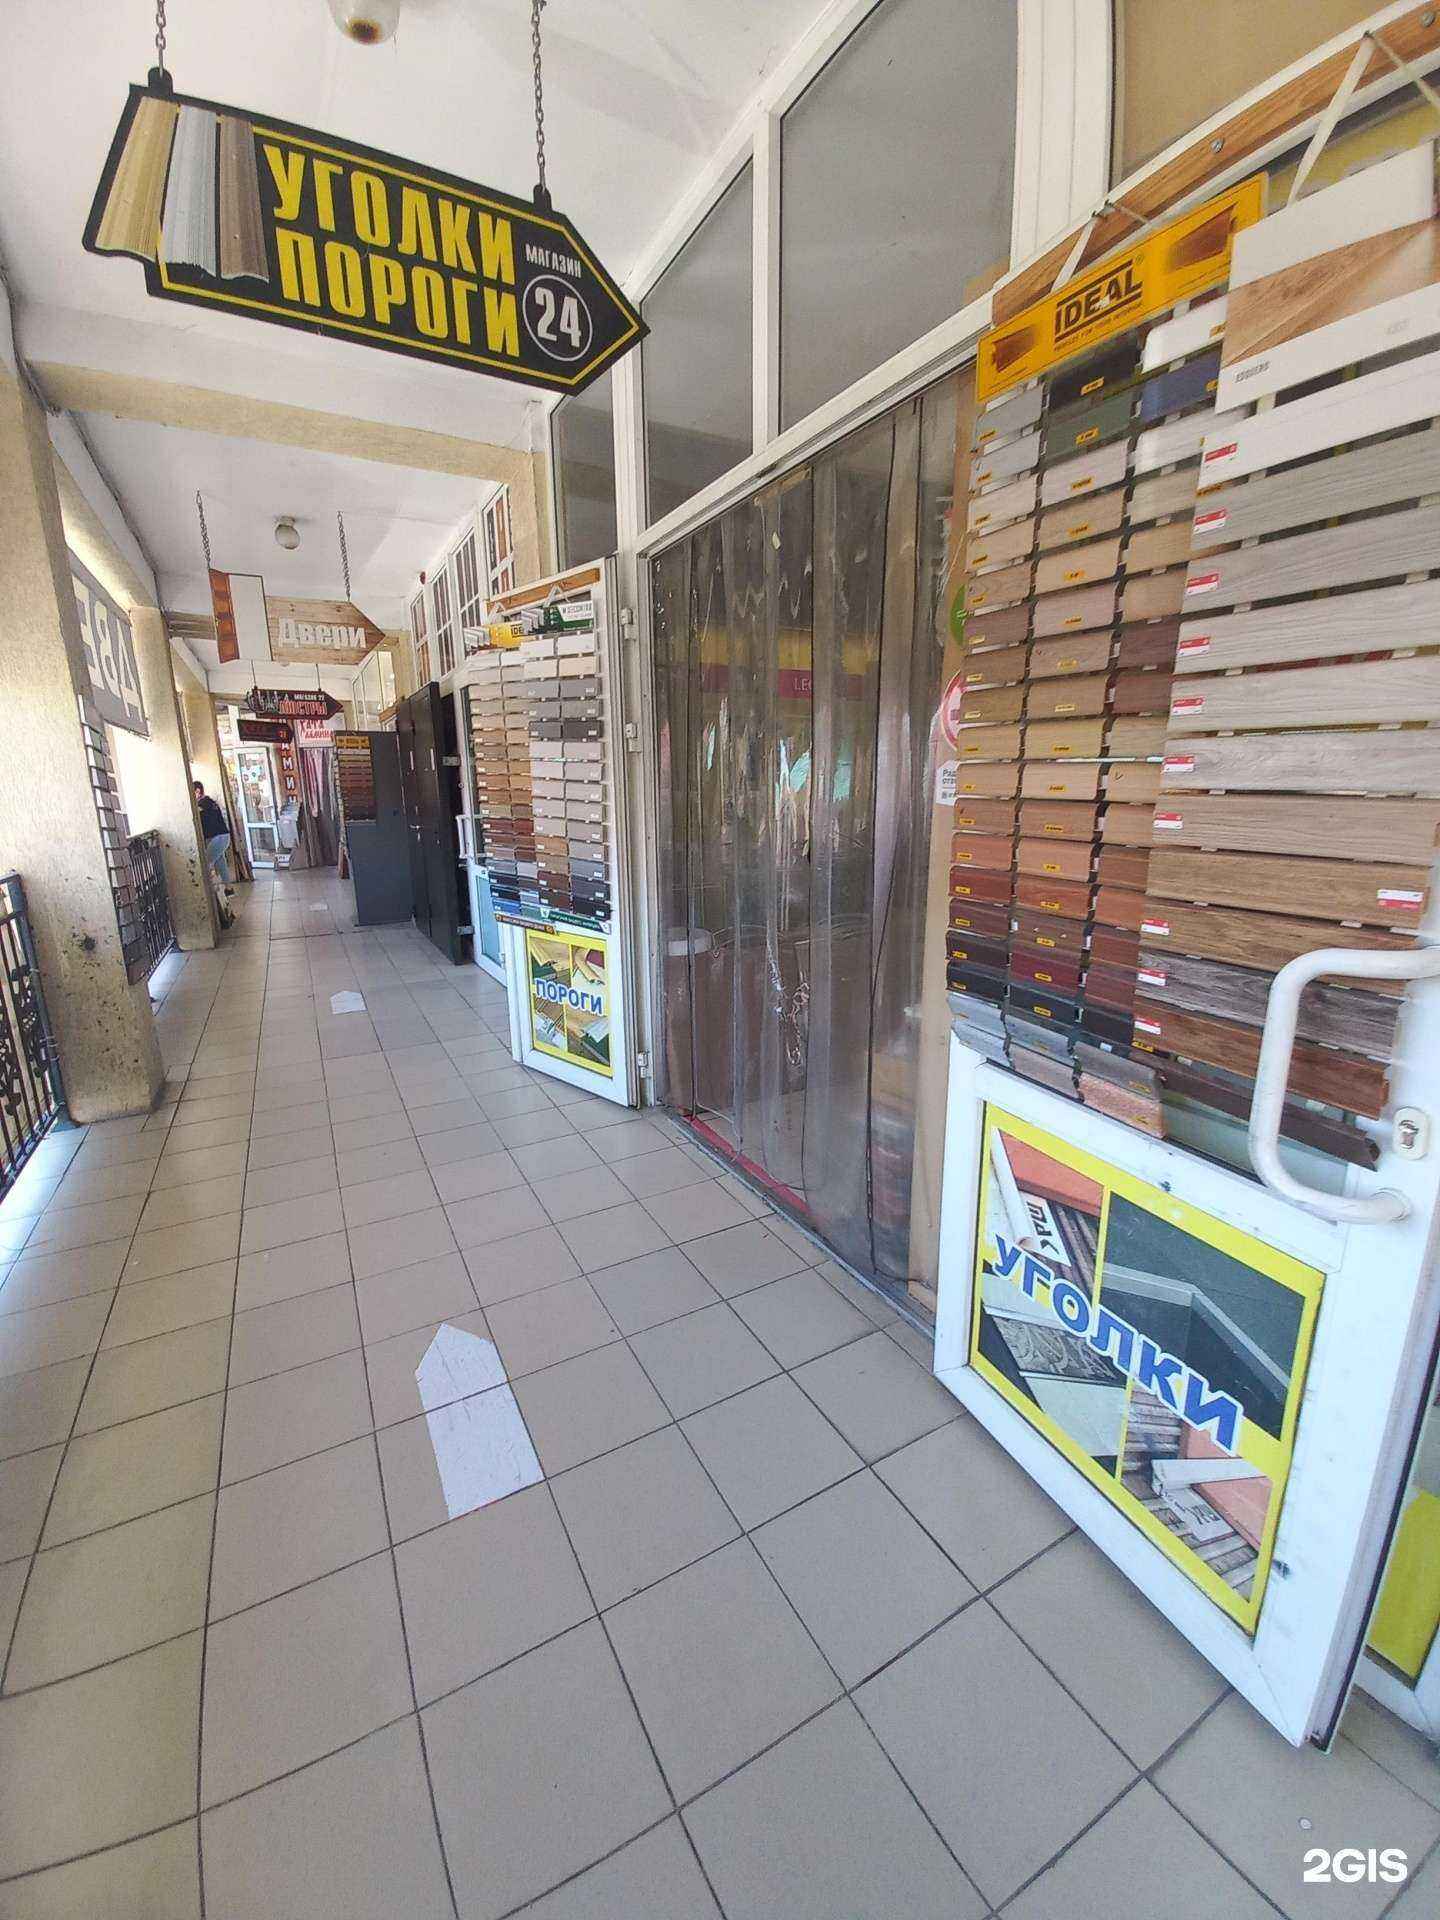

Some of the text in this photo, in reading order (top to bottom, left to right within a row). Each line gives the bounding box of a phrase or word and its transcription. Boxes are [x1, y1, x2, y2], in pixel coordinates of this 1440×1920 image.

[263, 143, 516, 285] УГОЛКИ
[275, 226, 520, 357] ПОРОГИ
[525, 242, 582, 279] МАГАЗИН
[532, 286, 583, 348] 24
[1054, 267, 1143, 336] IDEAL
[536, 979, 603, 1015] ПОРОГИ
[993, 1233, 1242, 1453] УГОЛКИ
